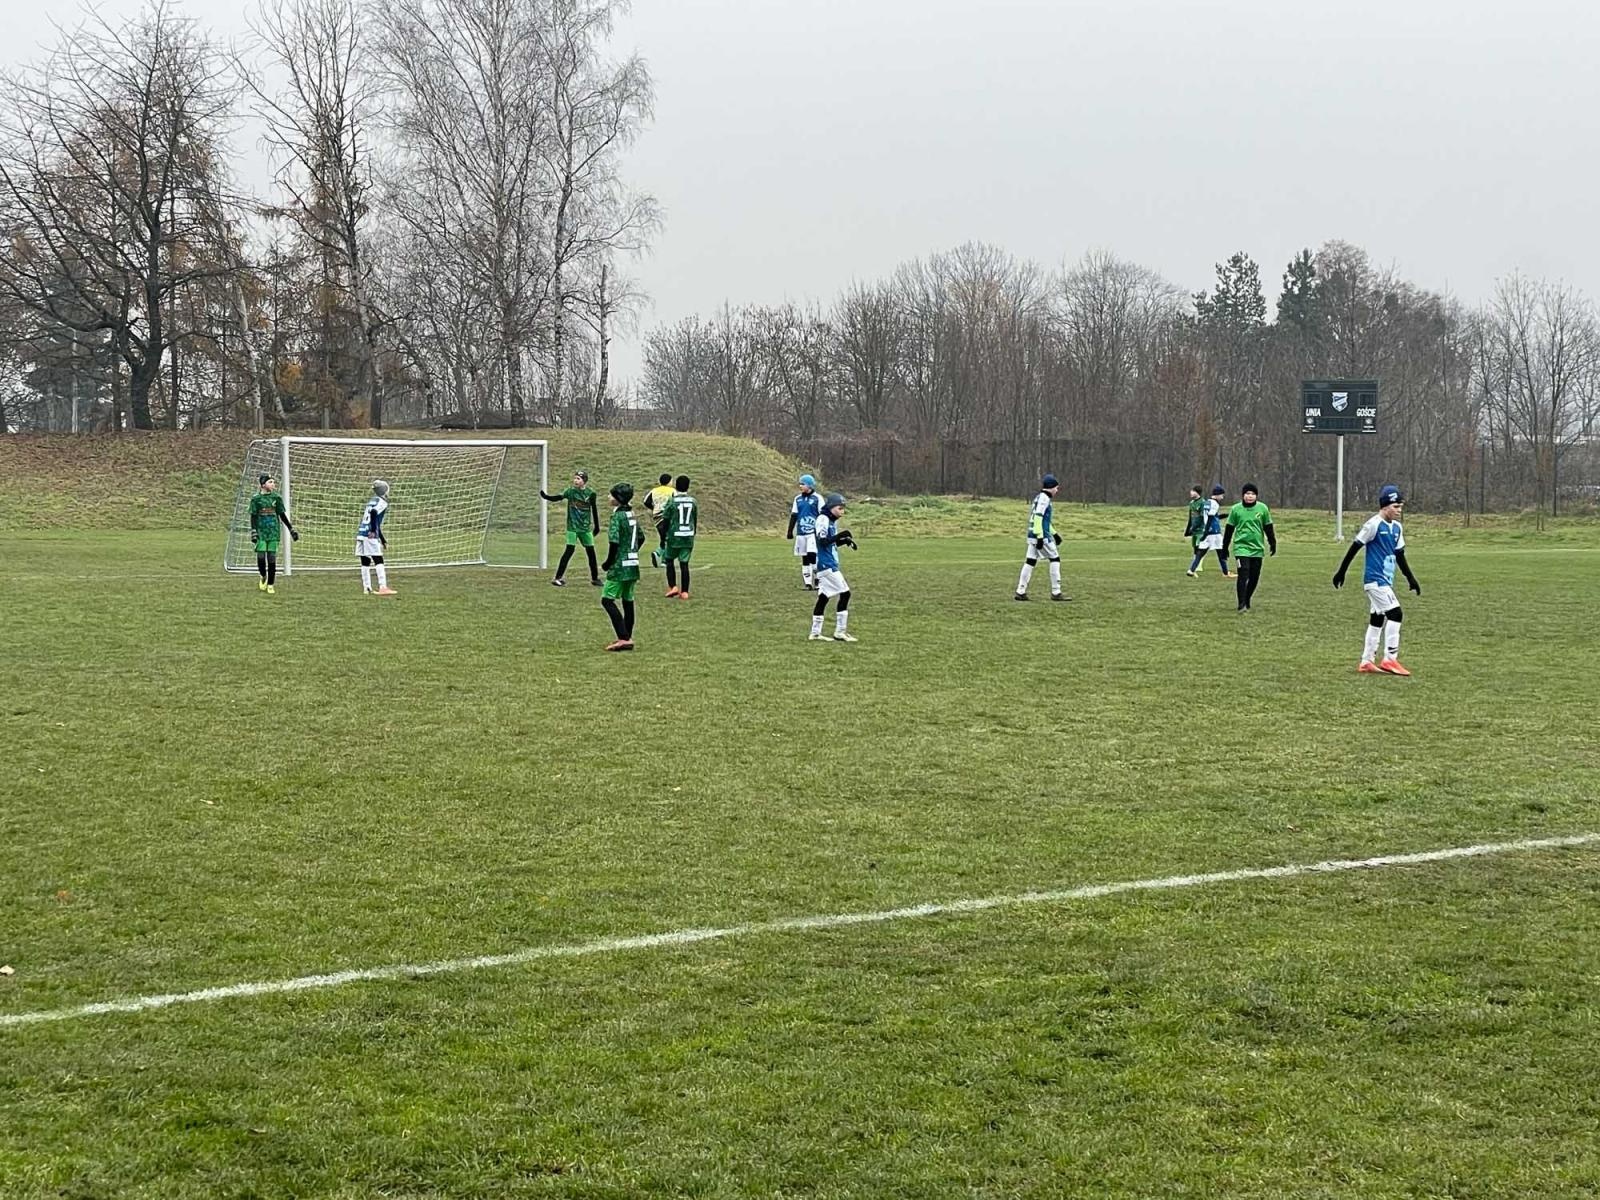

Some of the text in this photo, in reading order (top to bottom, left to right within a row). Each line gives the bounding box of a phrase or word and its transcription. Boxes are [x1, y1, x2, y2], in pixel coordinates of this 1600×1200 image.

[1305, 407, 1321, 417] UNIA
[1356, 405, 1377, 417] GOŚCIE
[677, 502, 693, 525] 17
[628, 519, 637, 550] 7
